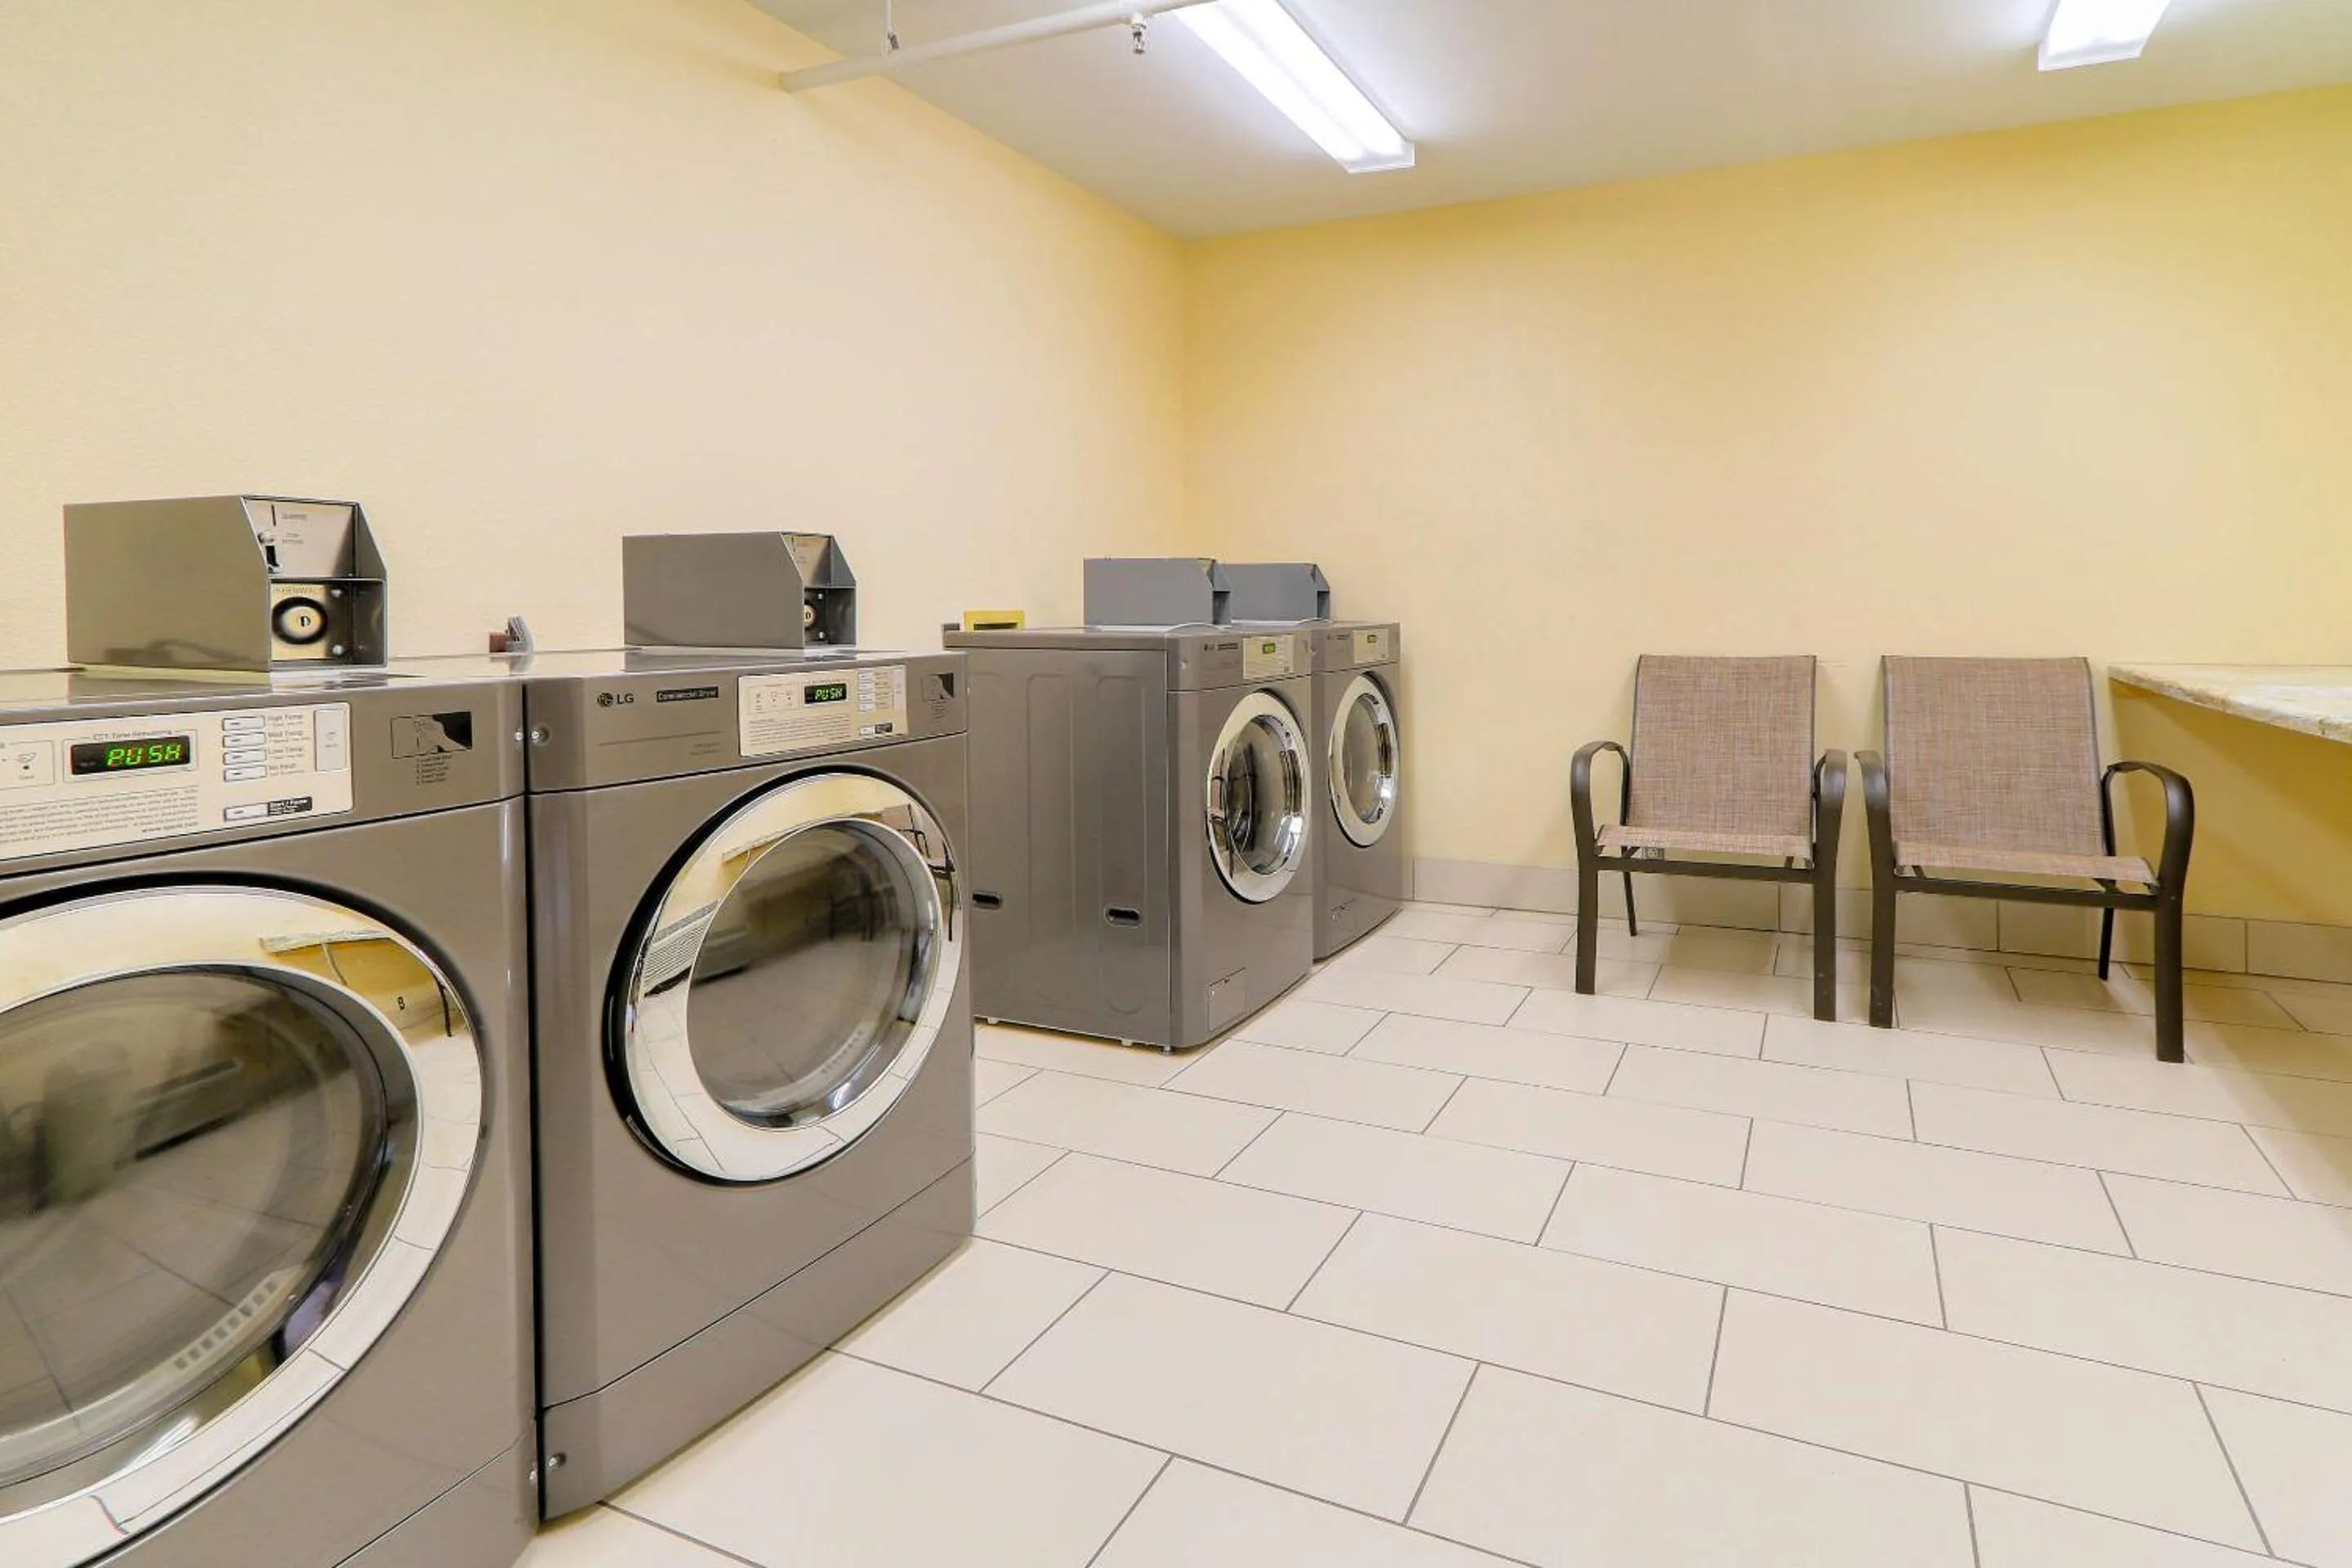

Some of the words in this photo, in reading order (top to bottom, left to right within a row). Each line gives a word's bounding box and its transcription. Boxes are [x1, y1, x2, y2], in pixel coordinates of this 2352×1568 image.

[617, 693, 635, 705] LG
[814, 687, 843, 701] PUSH
[107, 743, 181, 766] PUSH
